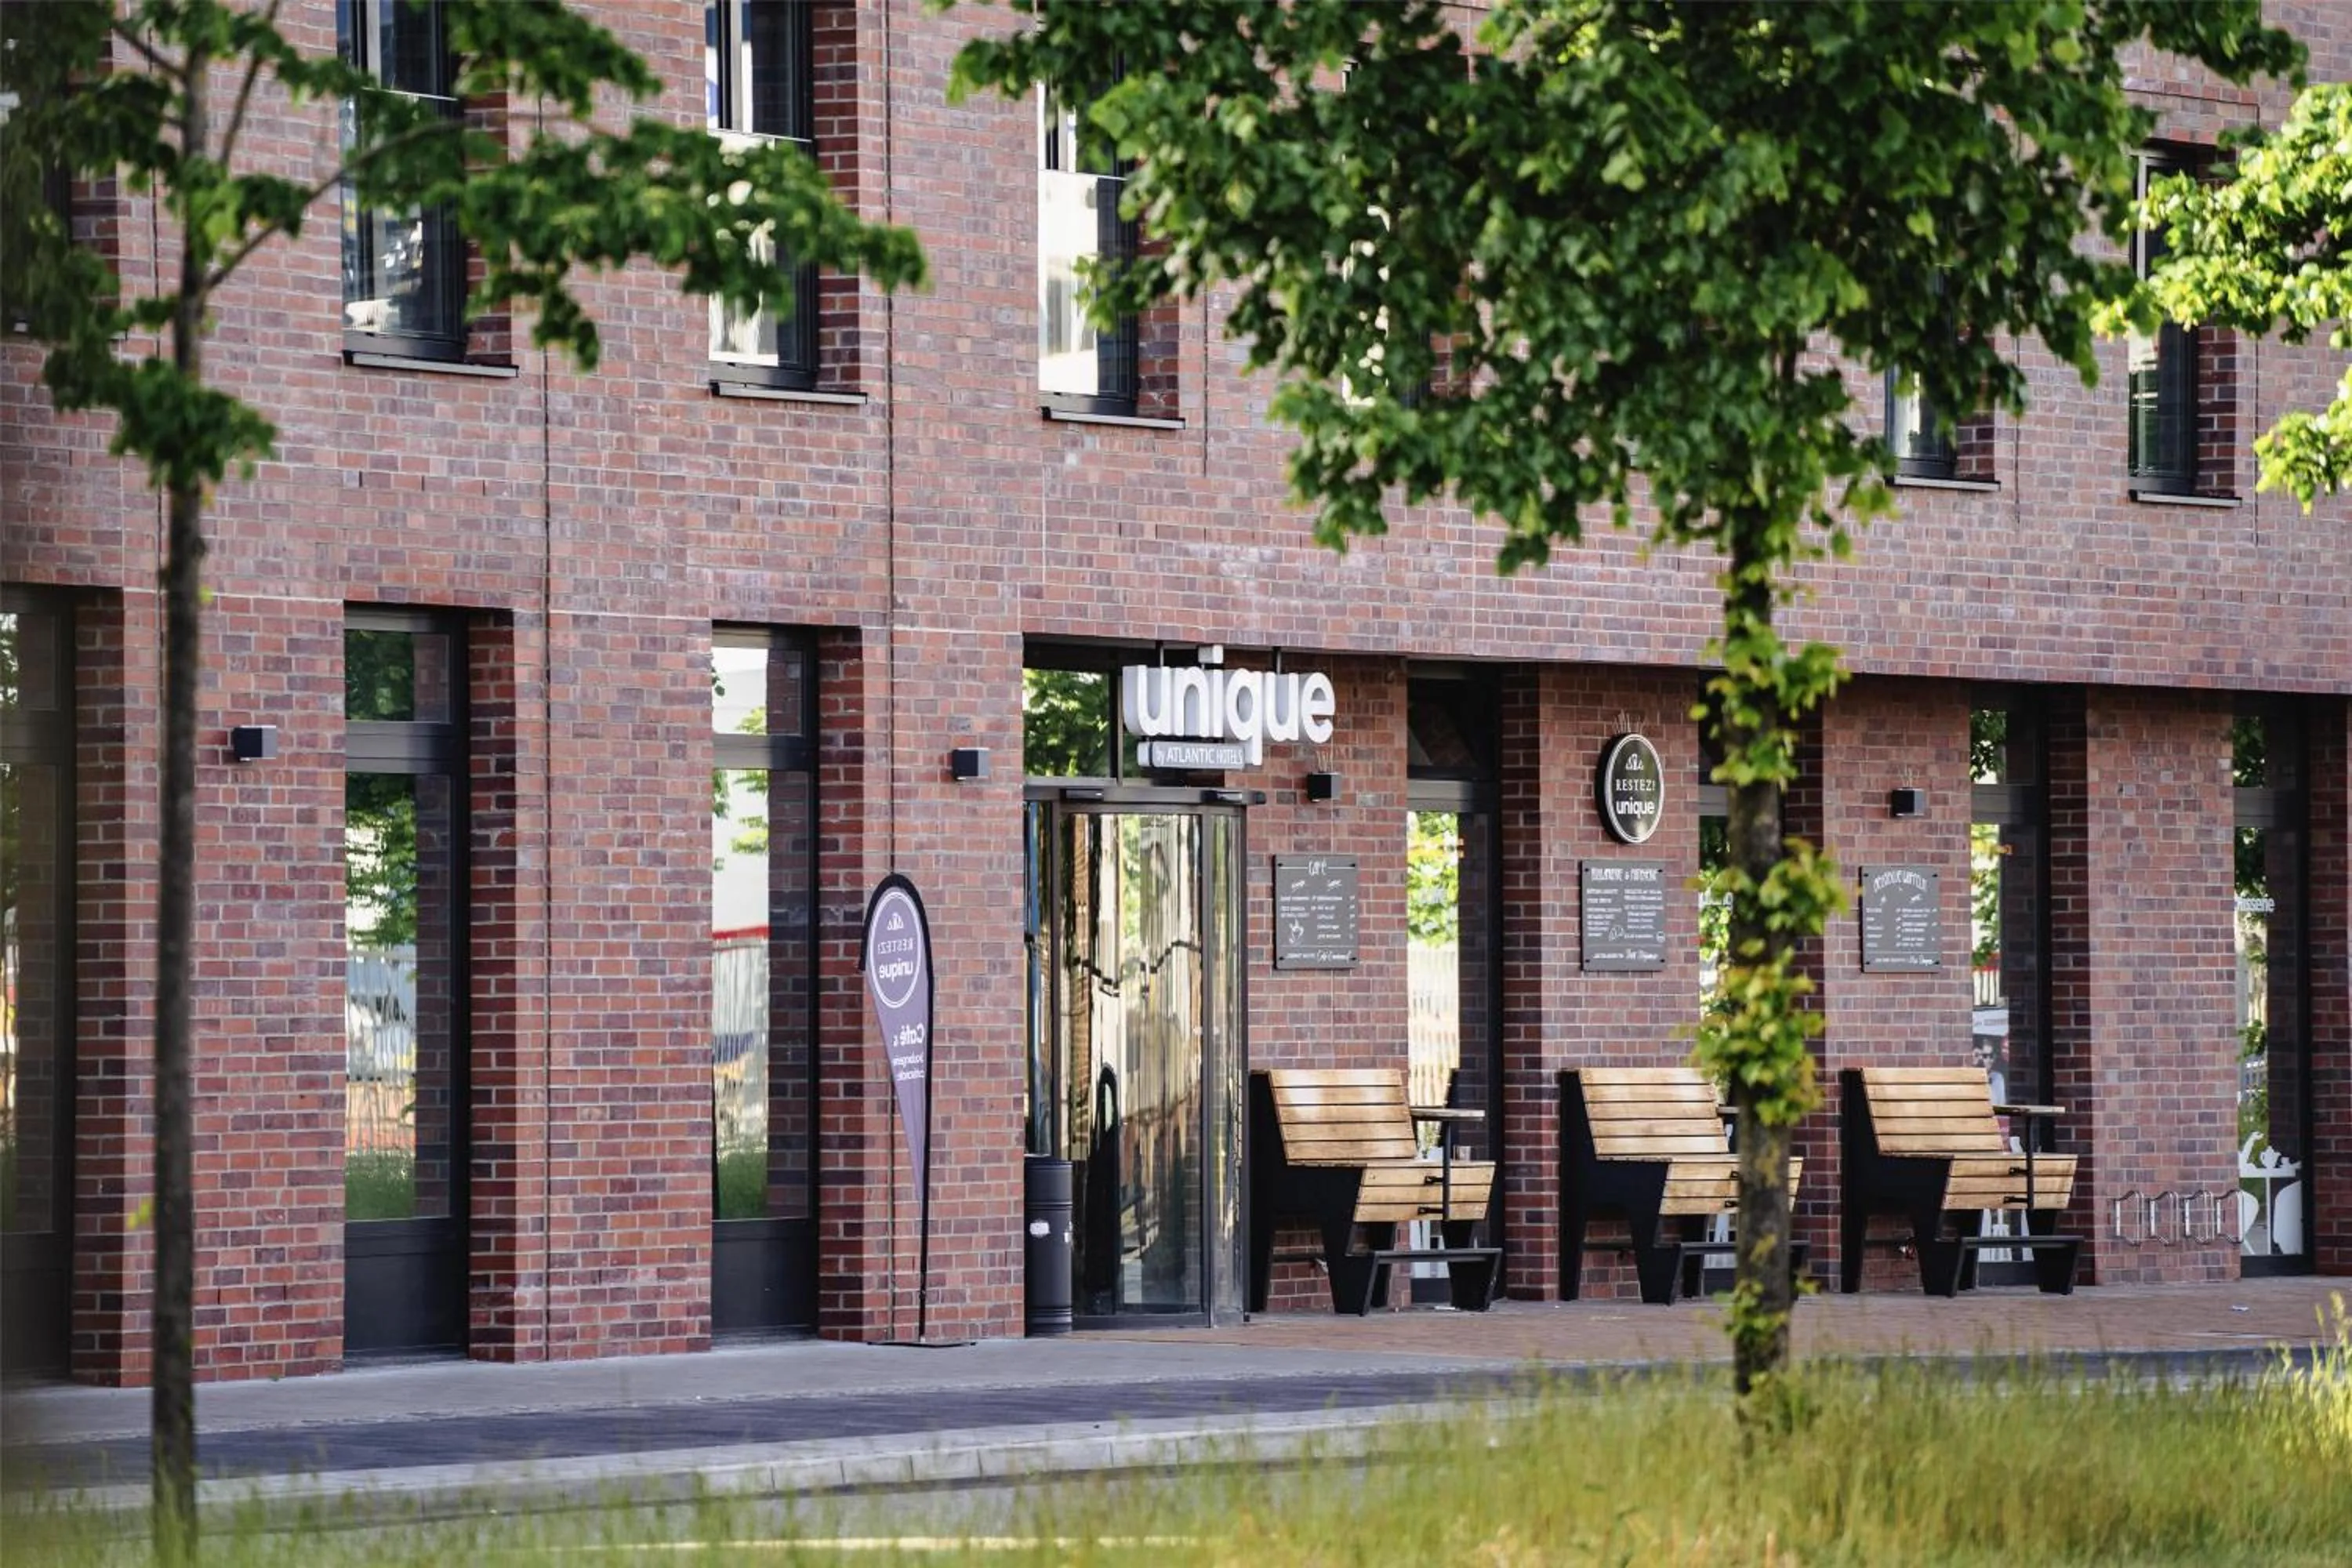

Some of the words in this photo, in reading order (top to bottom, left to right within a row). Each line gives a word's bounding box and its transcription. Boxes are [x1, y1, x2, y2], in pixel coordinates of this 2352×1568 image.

[1123, 644, 1336, 766] unique
[1156, 749, 1166, 765] by
[1167, 747, 1215, 764] ATLANTIC
[1217, 749, 1243, 764] HOTELS
[1616, 779, 1656, 792] RESTEZ!
[1616, 797, 1656, 818] unique
